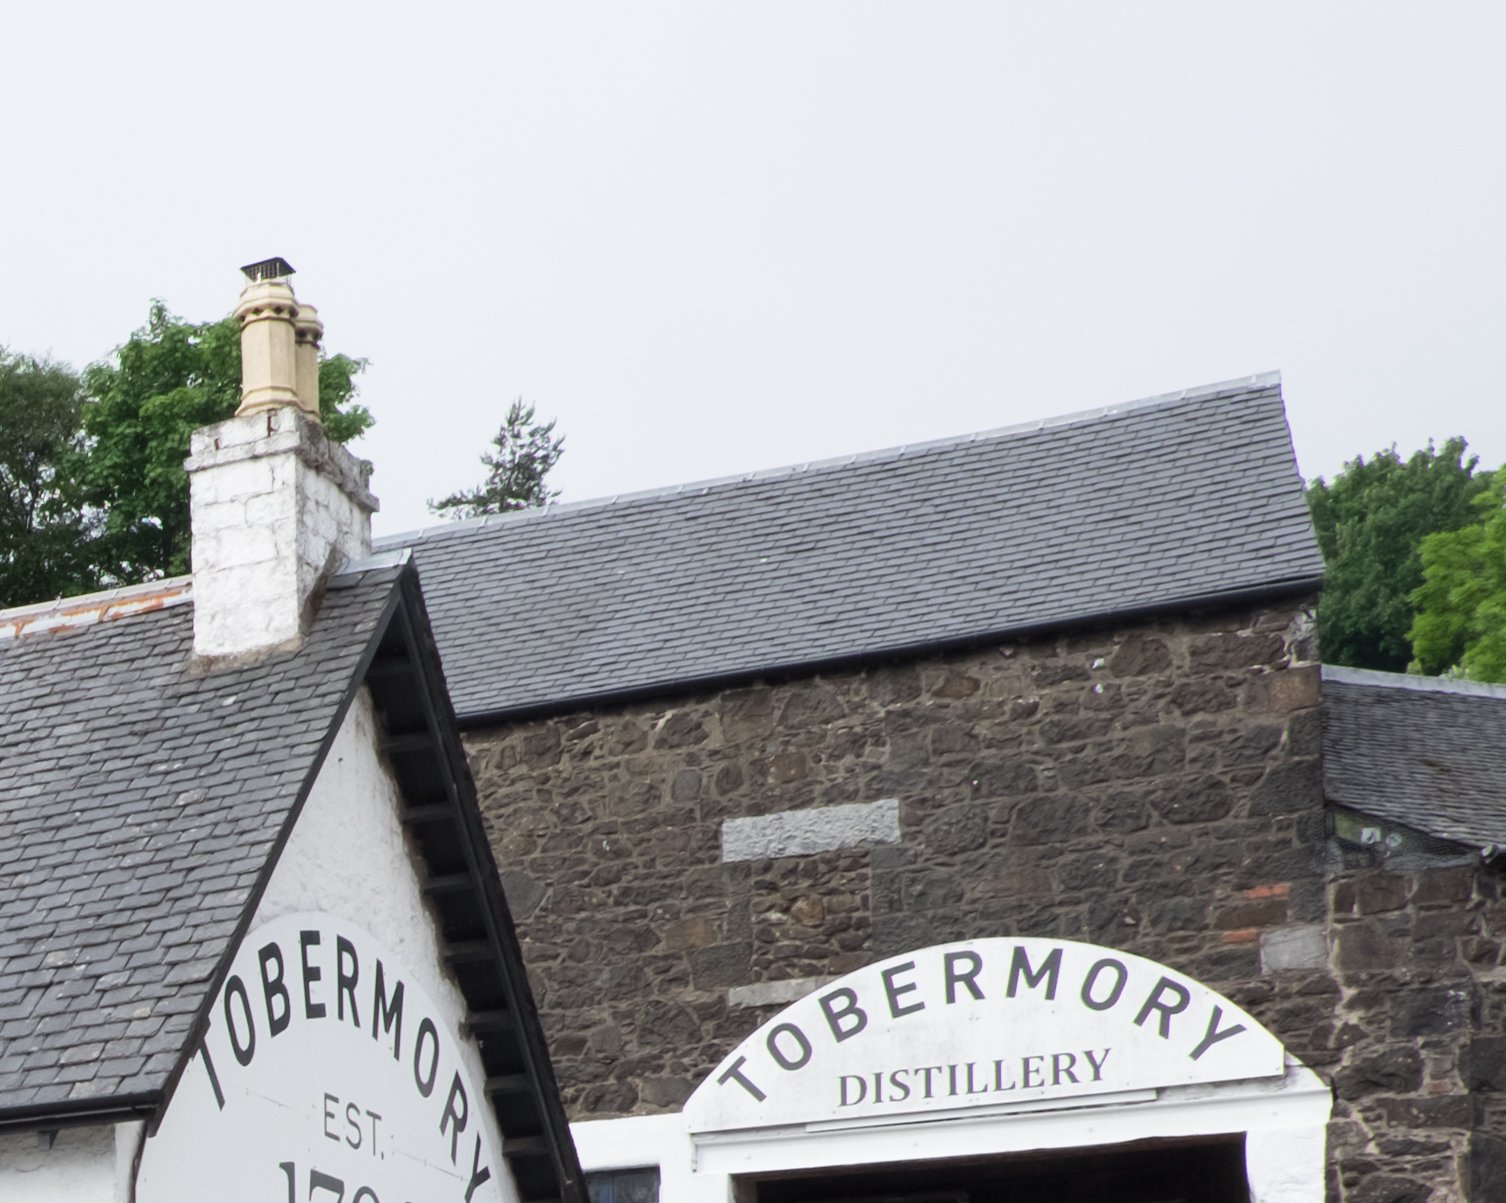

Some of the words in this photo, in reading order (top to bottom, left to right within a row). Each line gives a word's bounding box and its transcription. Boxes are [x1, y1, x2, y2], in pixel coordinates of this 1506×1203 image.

[718, 946, 1247, 1105] TOBERMORY
[838, 1047, 1113, 1107] DISTILLERY
[323, 1091, 385, 1161] EST.
